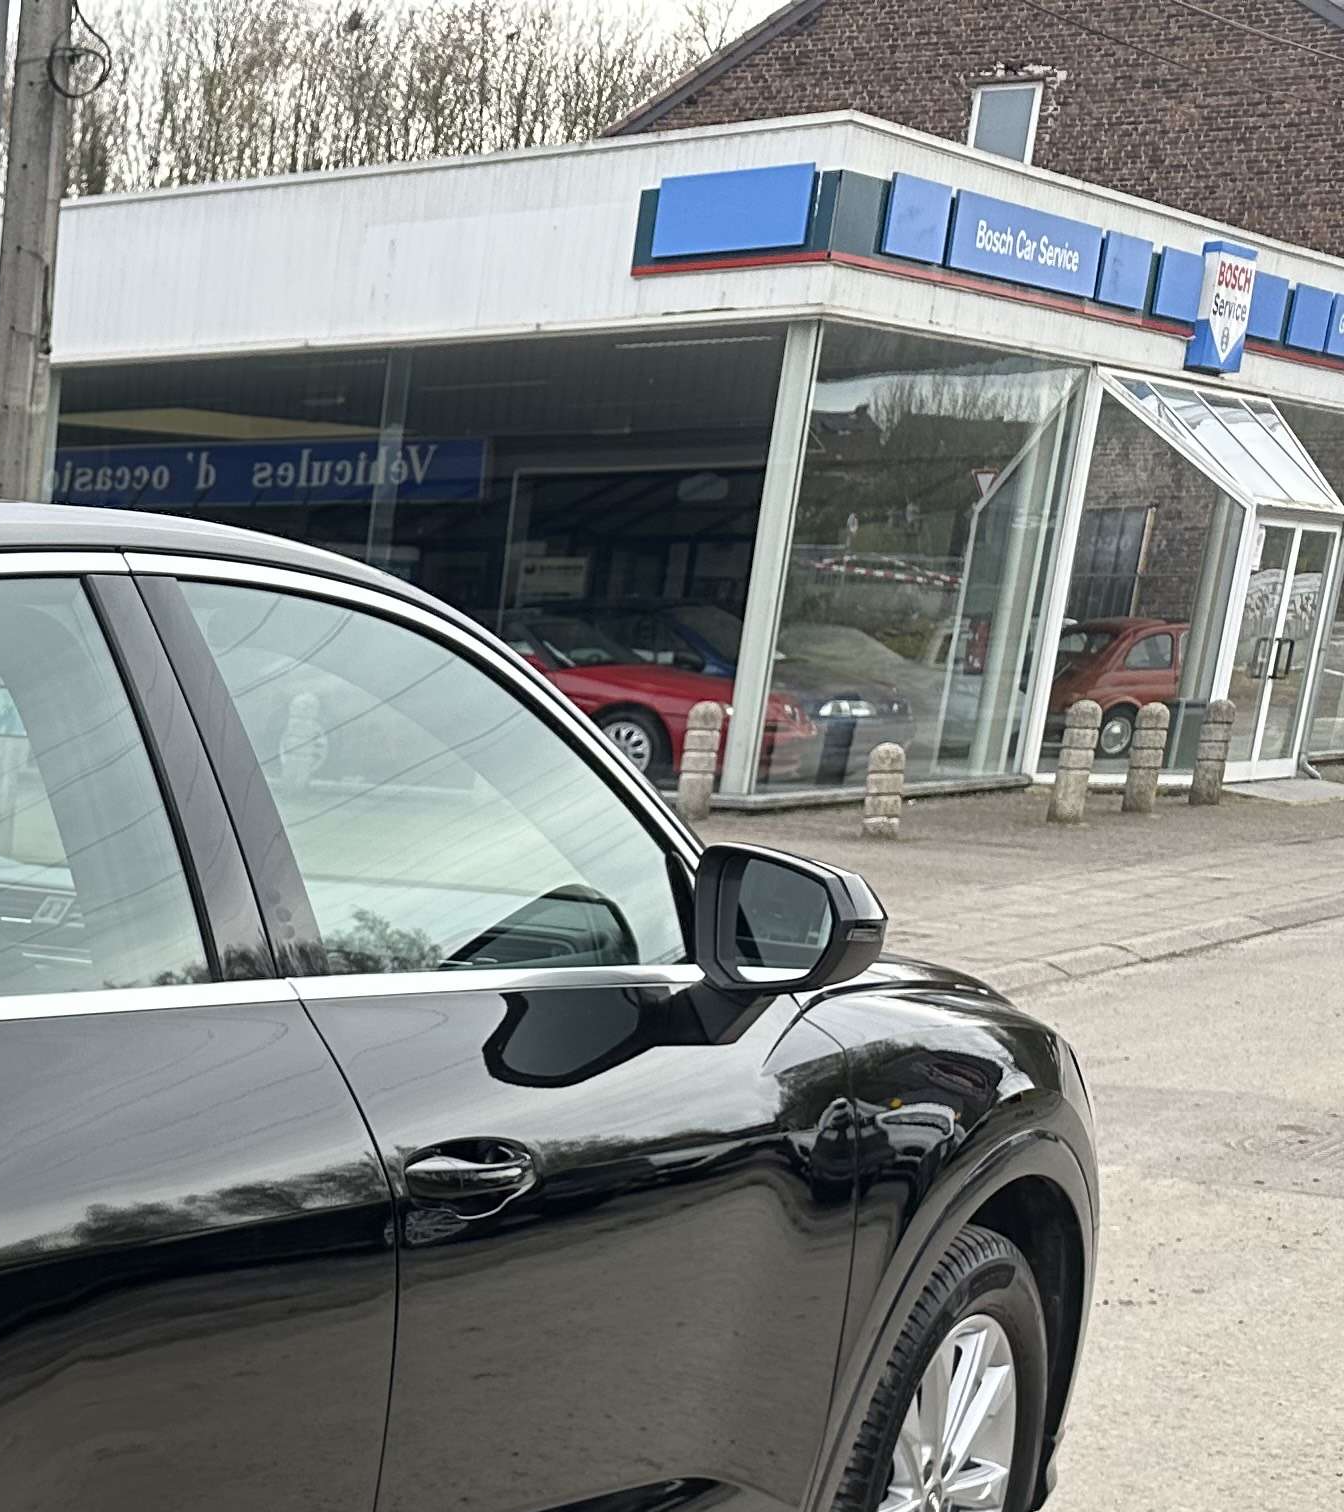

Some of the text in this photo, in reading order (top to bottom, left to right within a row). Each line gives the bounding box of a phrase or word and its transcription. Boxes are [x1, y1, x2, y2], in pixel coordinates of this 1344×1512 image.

[975, 219, 1080, 273] Bosch Car Service
[1217, 260, 1253, 294] BOSCH
[1212, 292, 1248, 322] Service
